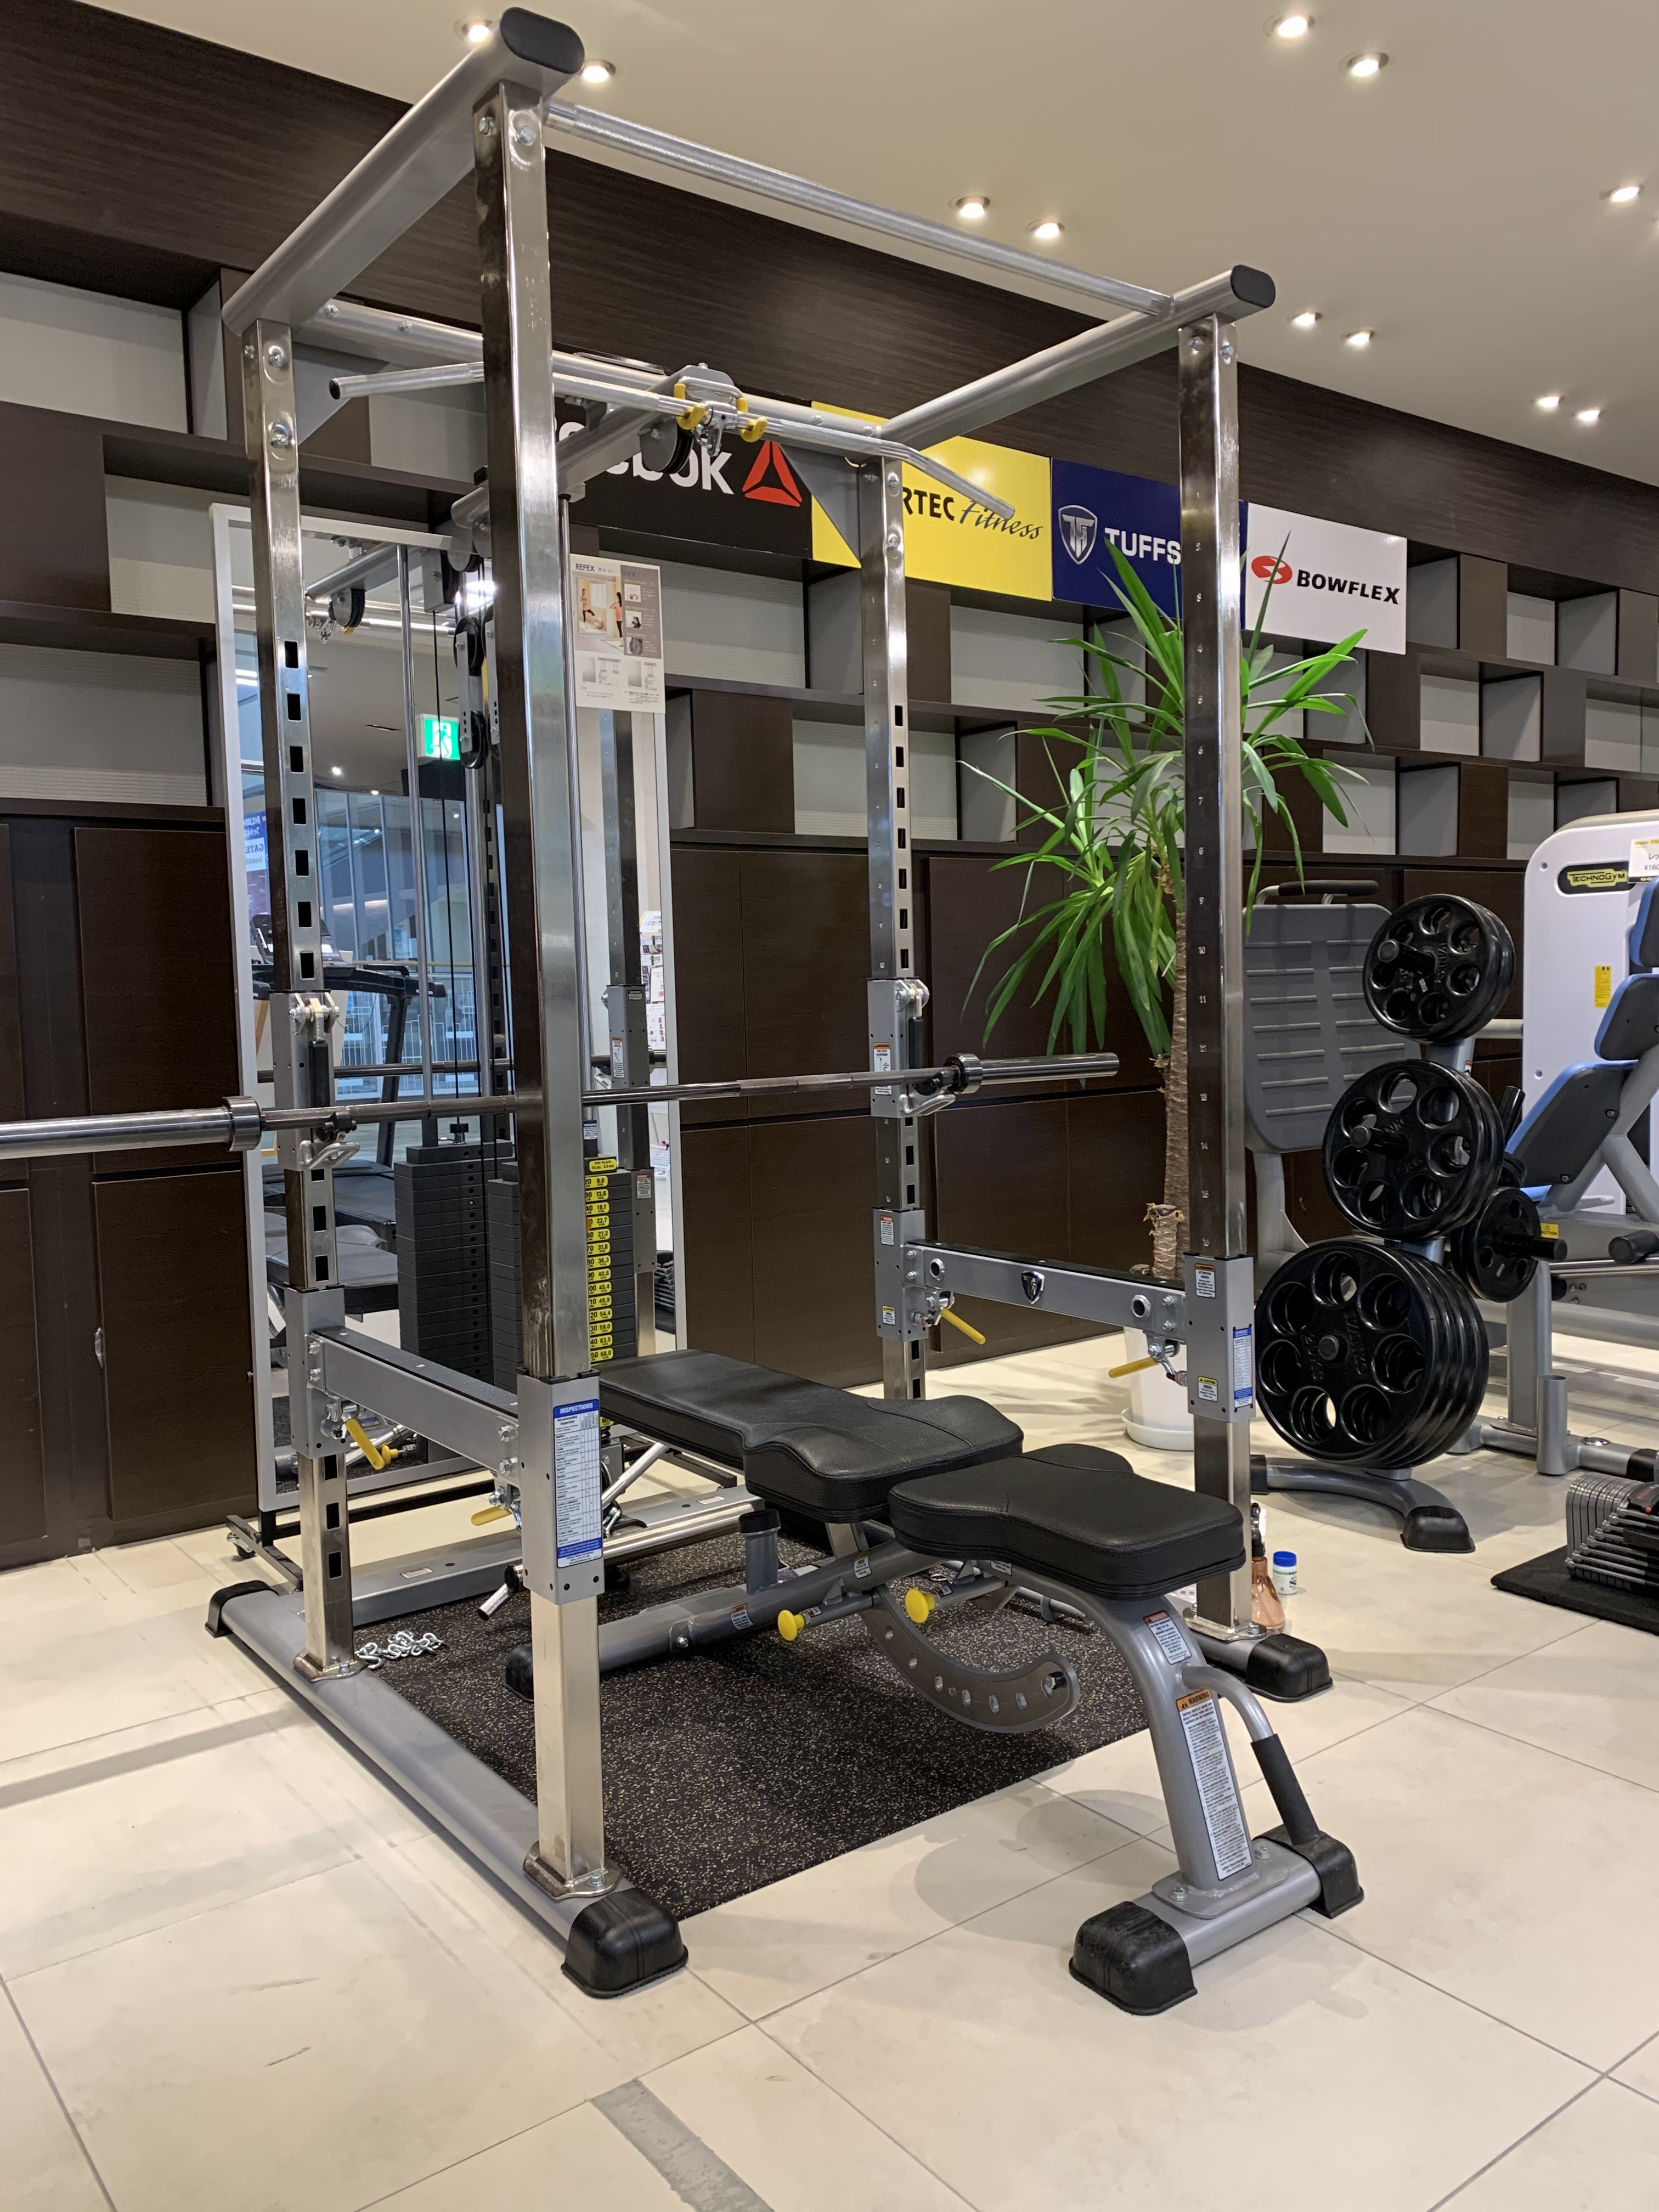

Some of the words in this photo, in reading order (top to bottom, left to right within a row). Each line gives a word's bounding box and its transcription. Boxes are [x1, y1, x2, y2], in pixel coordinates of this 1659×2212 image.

[902, 487, 955, 521] RTEC
[960, 500, 1043, 539] Fitness
[1104, 527, 1181, 565] TUFFS
[575, 563, 595, 572] REFEX
[1297, 569, 1400, 605] BOWFLEX
[1198, 797, 1203, 805] 7
[560, 1403, 593, 1414] INSPECTIONS
